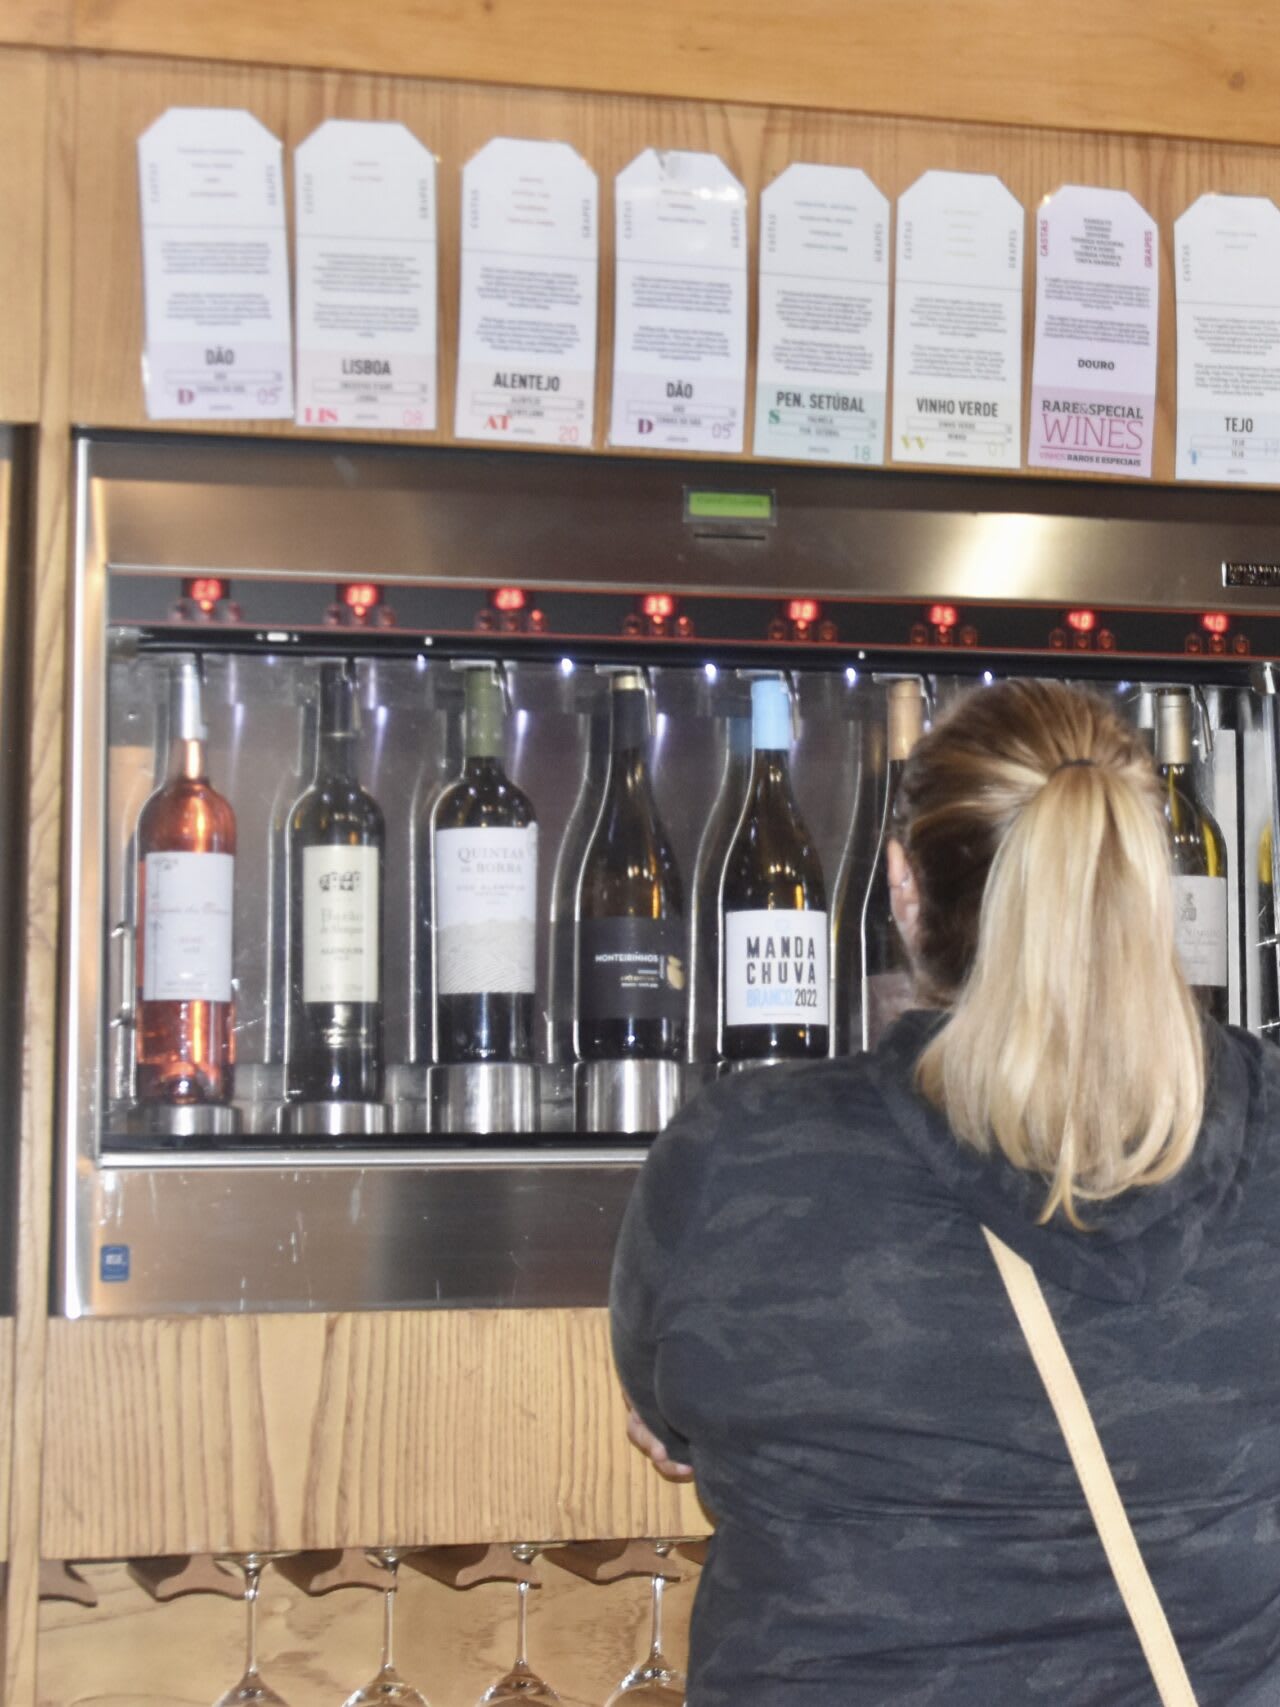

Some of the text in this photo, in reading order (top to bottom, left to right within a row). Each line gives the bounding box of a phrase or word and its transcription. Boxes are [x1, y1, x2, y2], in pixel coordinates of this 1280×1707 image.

[205, 346, 235, 365] DÃO
[1077, 359, 1116, 371] DOURO
[341, 358, 392, 375] LISBOA
[492, 372, 561, 392] ALENTEJO
[666, 379, 694, 399] DÃO
[776, 391, 865, 413] PEN. SETÚBAL
[916, 397, 999, 418] VINHO VERDE
[1041, 399, 1145, 420] RARE&SPECIAL
[1041, 412, 1144, 451] WINES
[1225, 416, 1254, 433] TEJO
[1067, 454, 1094, 464] RAROS
[1101, 457, 1142, 467] ESPECIAIS
[746, 935, 816, 959] MANDA
[746, 961, 817, 985] CHUVA
[795, 987, 818, 1008] 2022
